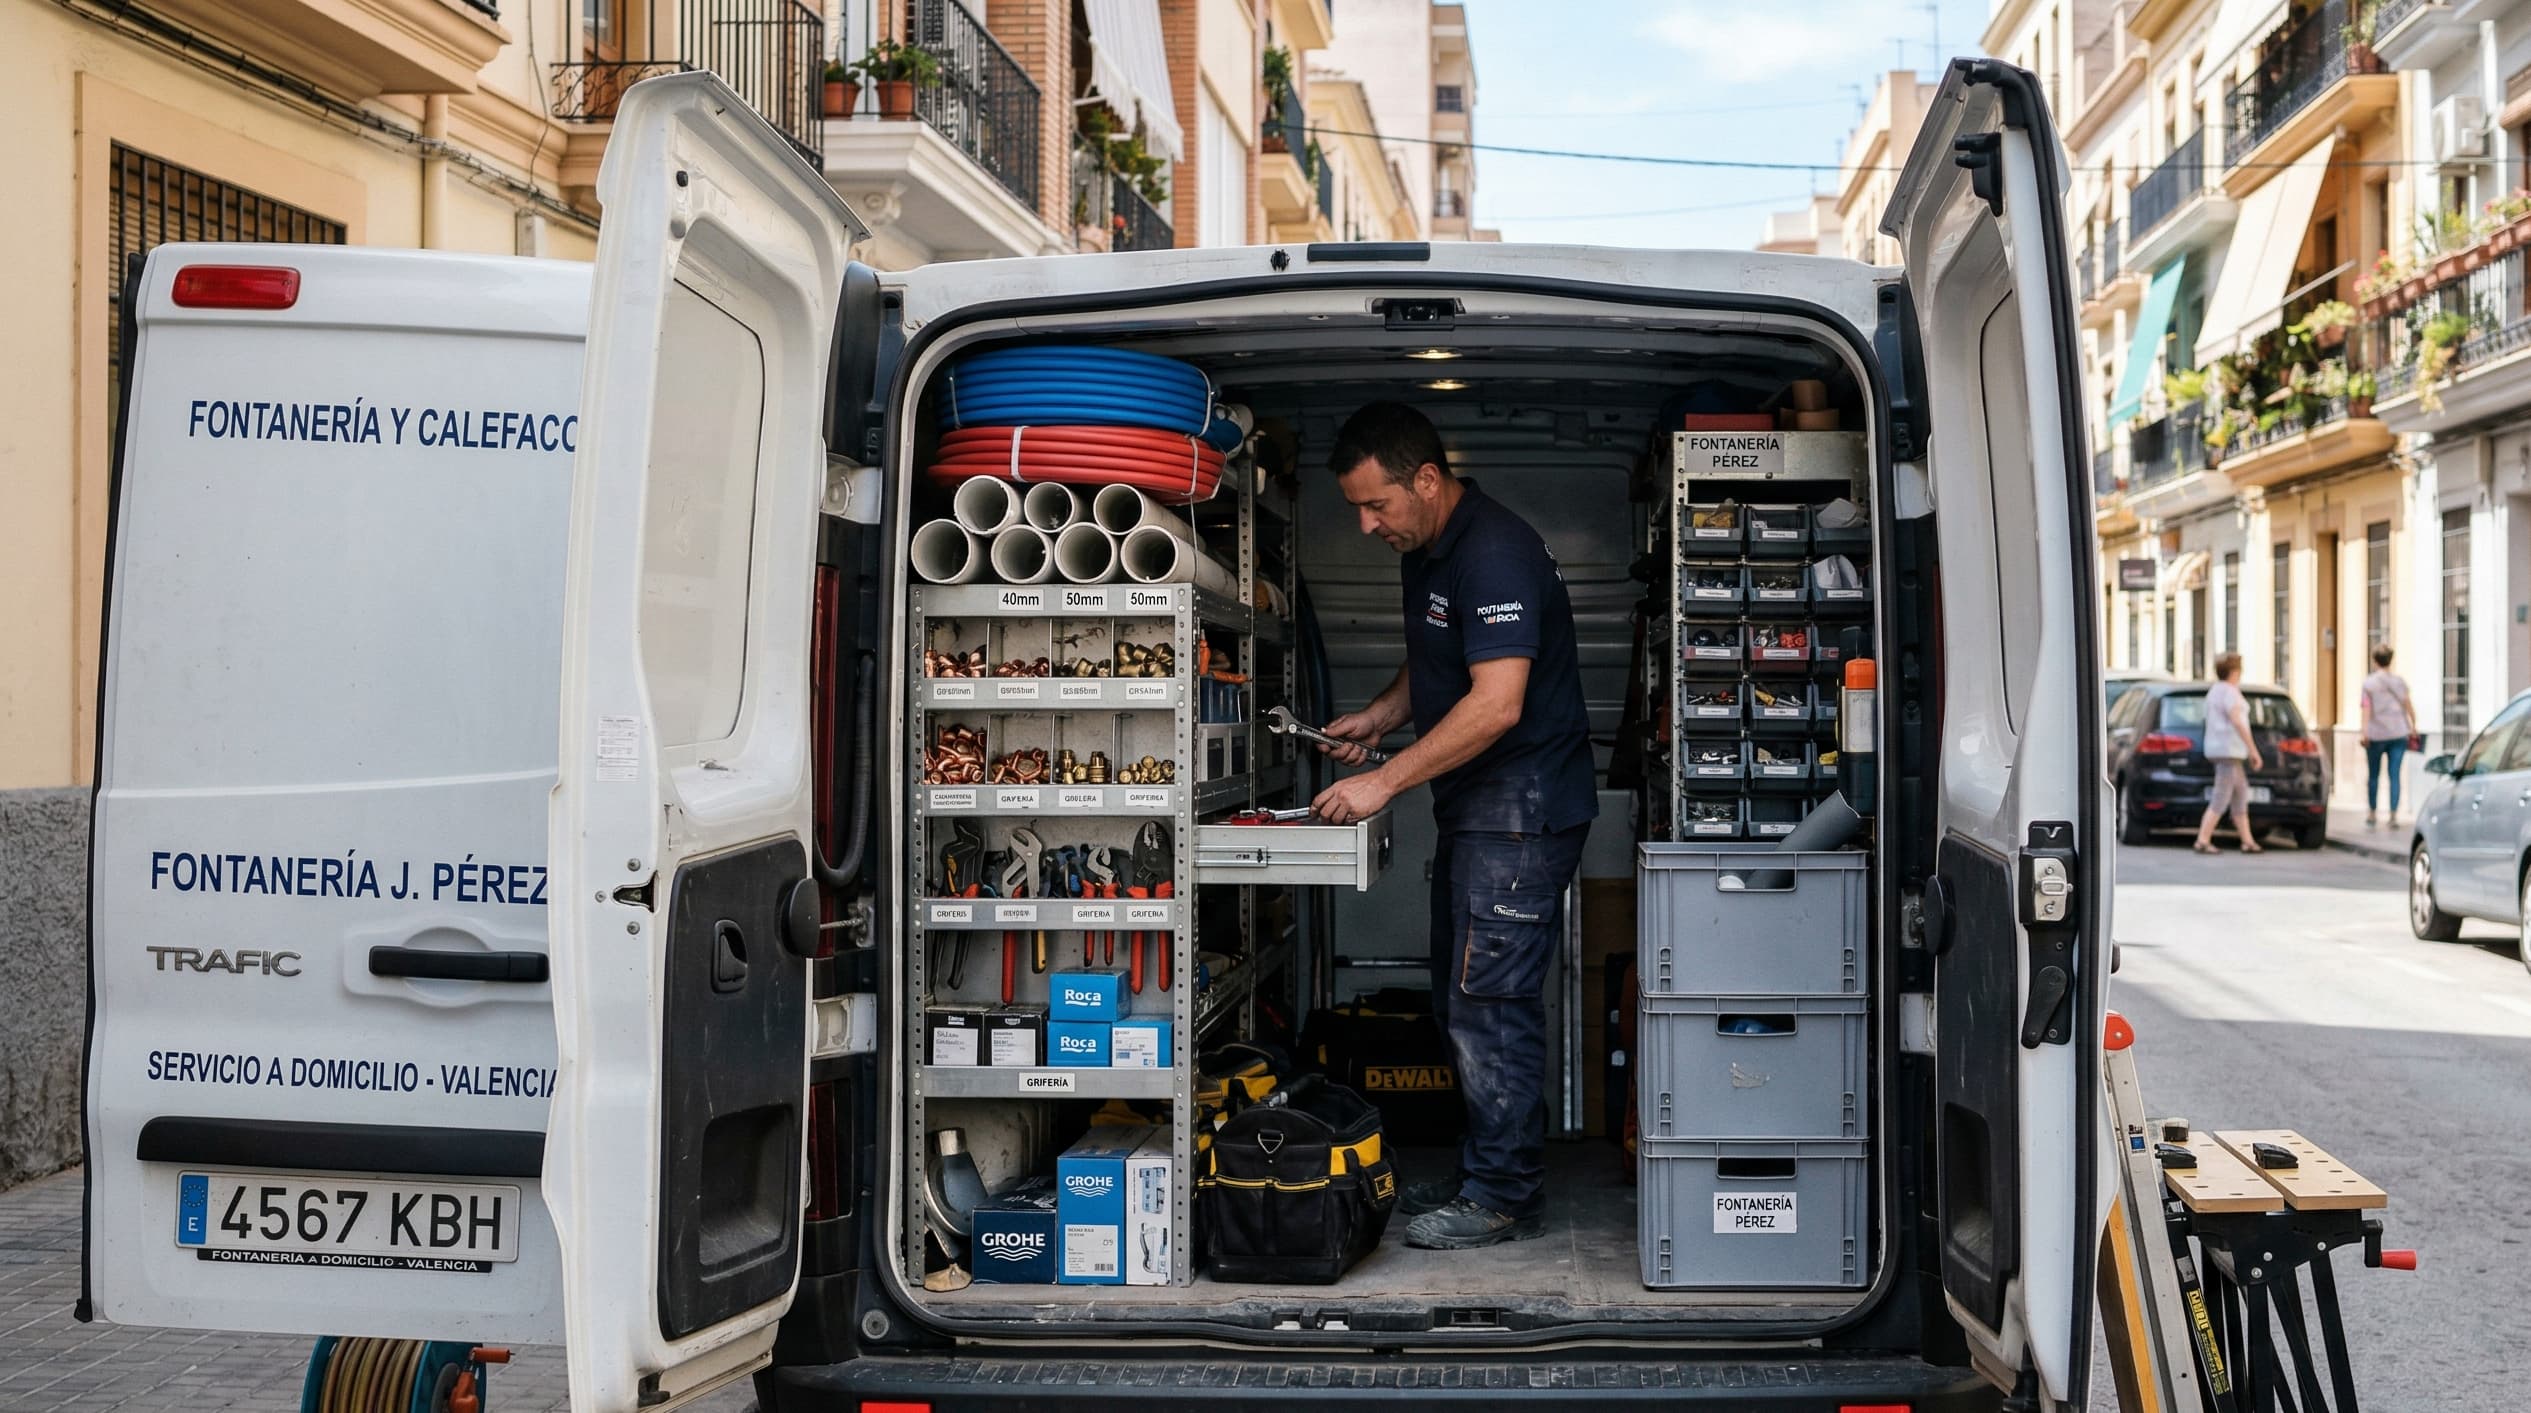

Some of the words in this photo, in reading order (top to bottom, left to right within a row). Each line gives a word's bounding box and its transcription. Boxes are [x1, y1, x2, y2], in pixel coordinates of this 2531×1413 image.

[189, 397, 382, 444] FONTANERÍA
[390, 407, 411, 445] Y
[1690, 434, 1780, 451] FONTANERÍA
[1712, 453, 1759, 468] PÉREZ
[1002, 592, 1040, 606] 40mm
[1066, 592, 1103, 606] 50mm
[1130, 592, 1168, 606] 50mm
[151, 849, 381, 898] FONTANERÍA
[390, 861, 419, 900] J.
[432, 853, 548, 905] PÉREZ
[146, 945, 303, 977] TRAFIC
[1064, 989, 1102, 1002] Roca
[1060, 1036, 1097, 1048] Roca
[147, 1050, 261, 1085] SERVICIO
[266, 1056, 284, 1086] A
[291, 1057, 419, 1092] DOMICILIO
[1026, 1076, 1069, 1087] GRIFERÍA
[1065, 1175, 1114, 1187] GROHE
[1716, 1194, 1793, 1211] FONTANERÍA
[187, 1216, 199, 1232] E
[220, 1185, 369, 1243] 4567
[389, 1192, 502, 1250] KBH
[1735, 1211, 1776, 1228] PÉREZ
[981, 1232, 1046, 1247] GROHE
[212, 1250, 305, 1264] FONTANERÍA
[308, 1255, 318, 1264] A
[321, 1255, 394, 1267] DOMICILIO
[406, 1259, 478, 1271] VALENCIA
